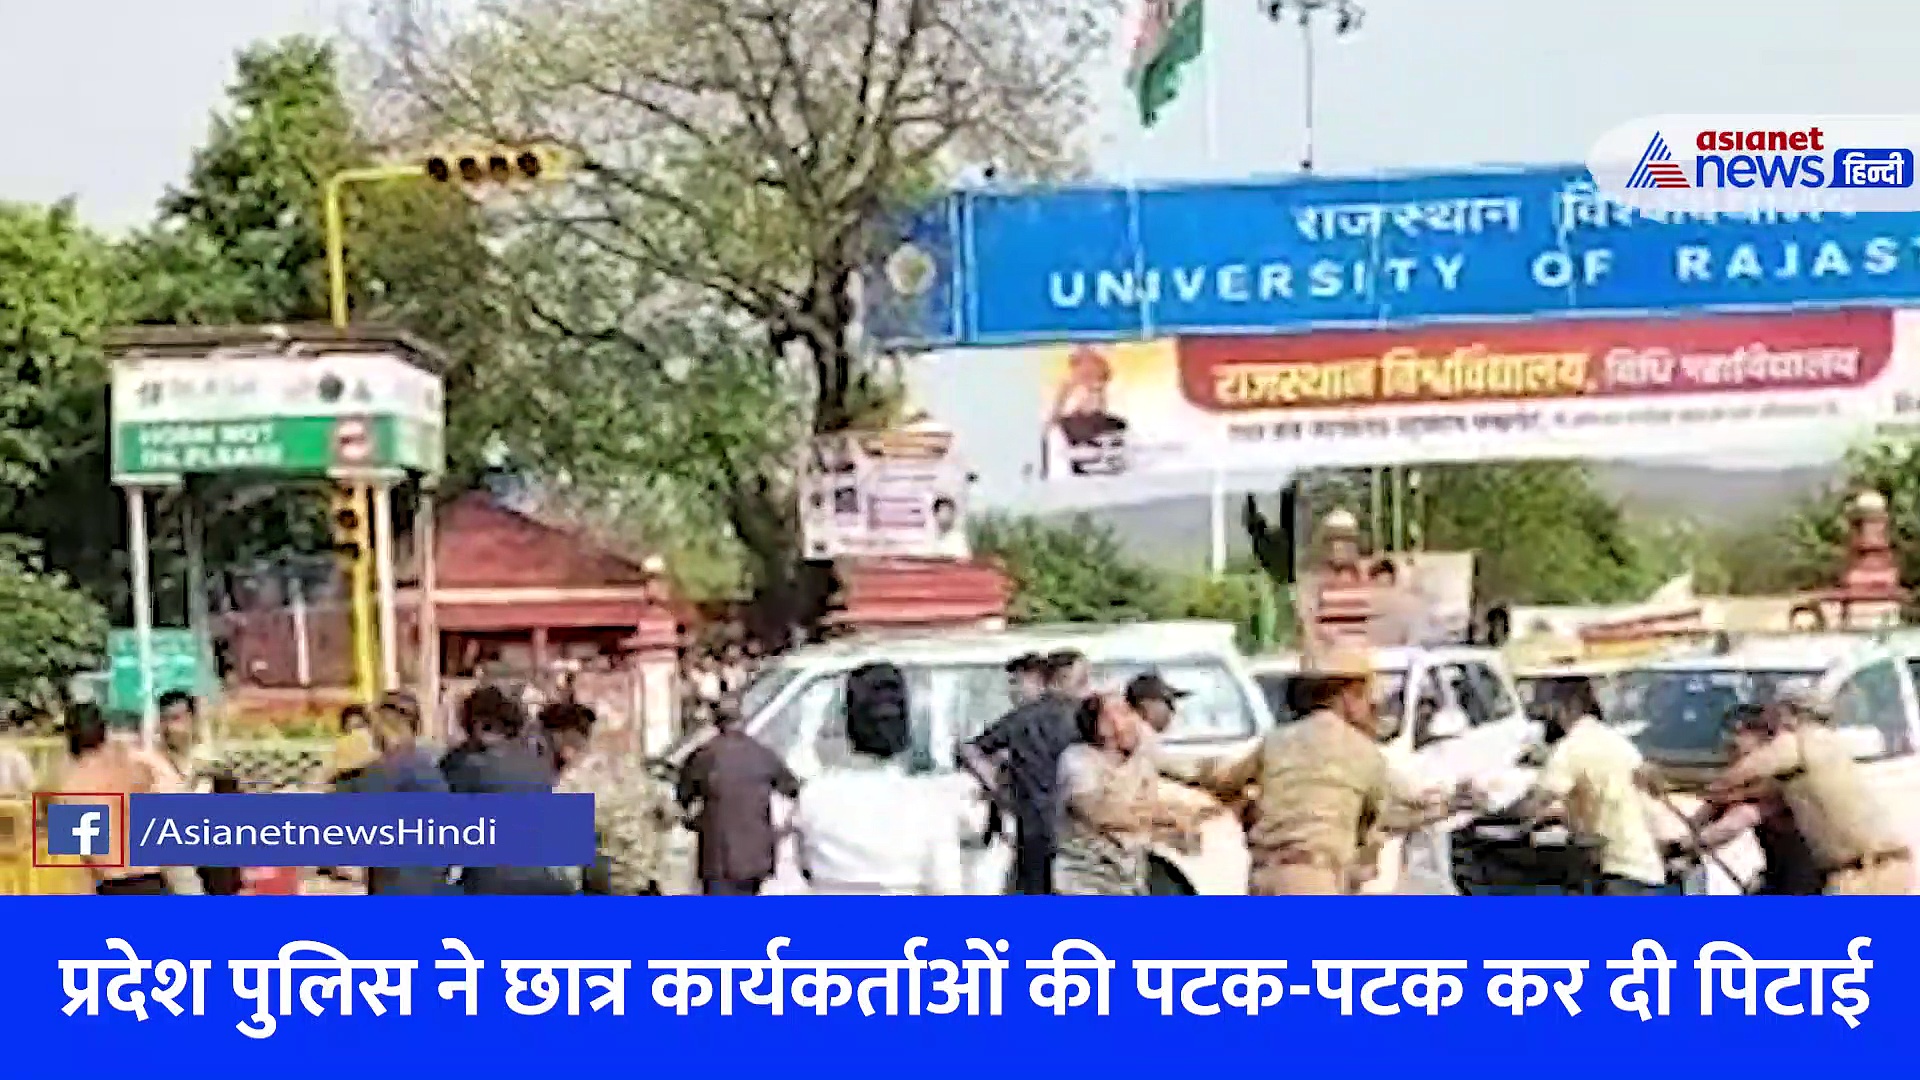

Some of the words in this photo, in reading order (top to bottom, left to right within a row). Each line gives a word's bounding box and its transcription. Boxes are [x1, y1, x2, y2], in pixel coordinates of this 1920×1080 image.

[1291, 196, 1521, 242] राजस्थान
[1047, 253, 1464, 309] UNIVERSITY
[1532, 249, 1615, 289] OF
